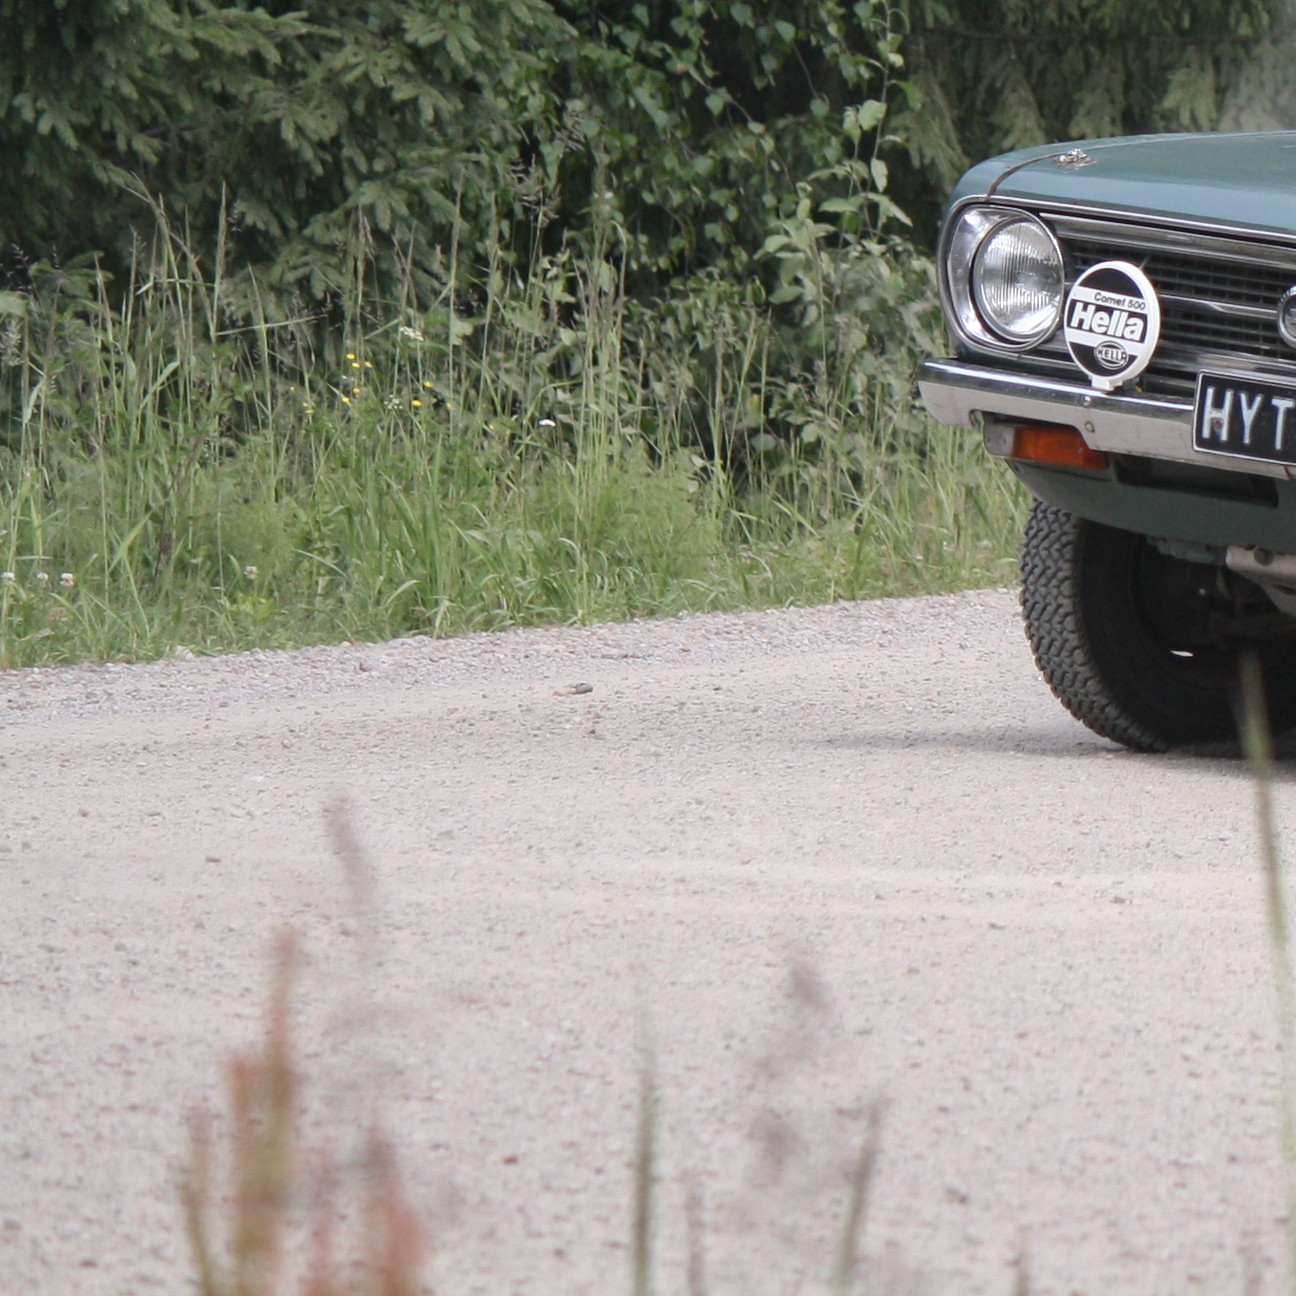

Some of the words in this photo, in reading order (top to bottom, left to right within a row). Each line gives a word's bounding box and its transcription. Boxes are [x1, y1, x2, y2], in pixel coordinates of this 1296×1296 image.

[1094, 292, 1125, 307] Comet
[1128, 299, 1146, 311] 500
[1070, 301, 1144, 341] Hella
